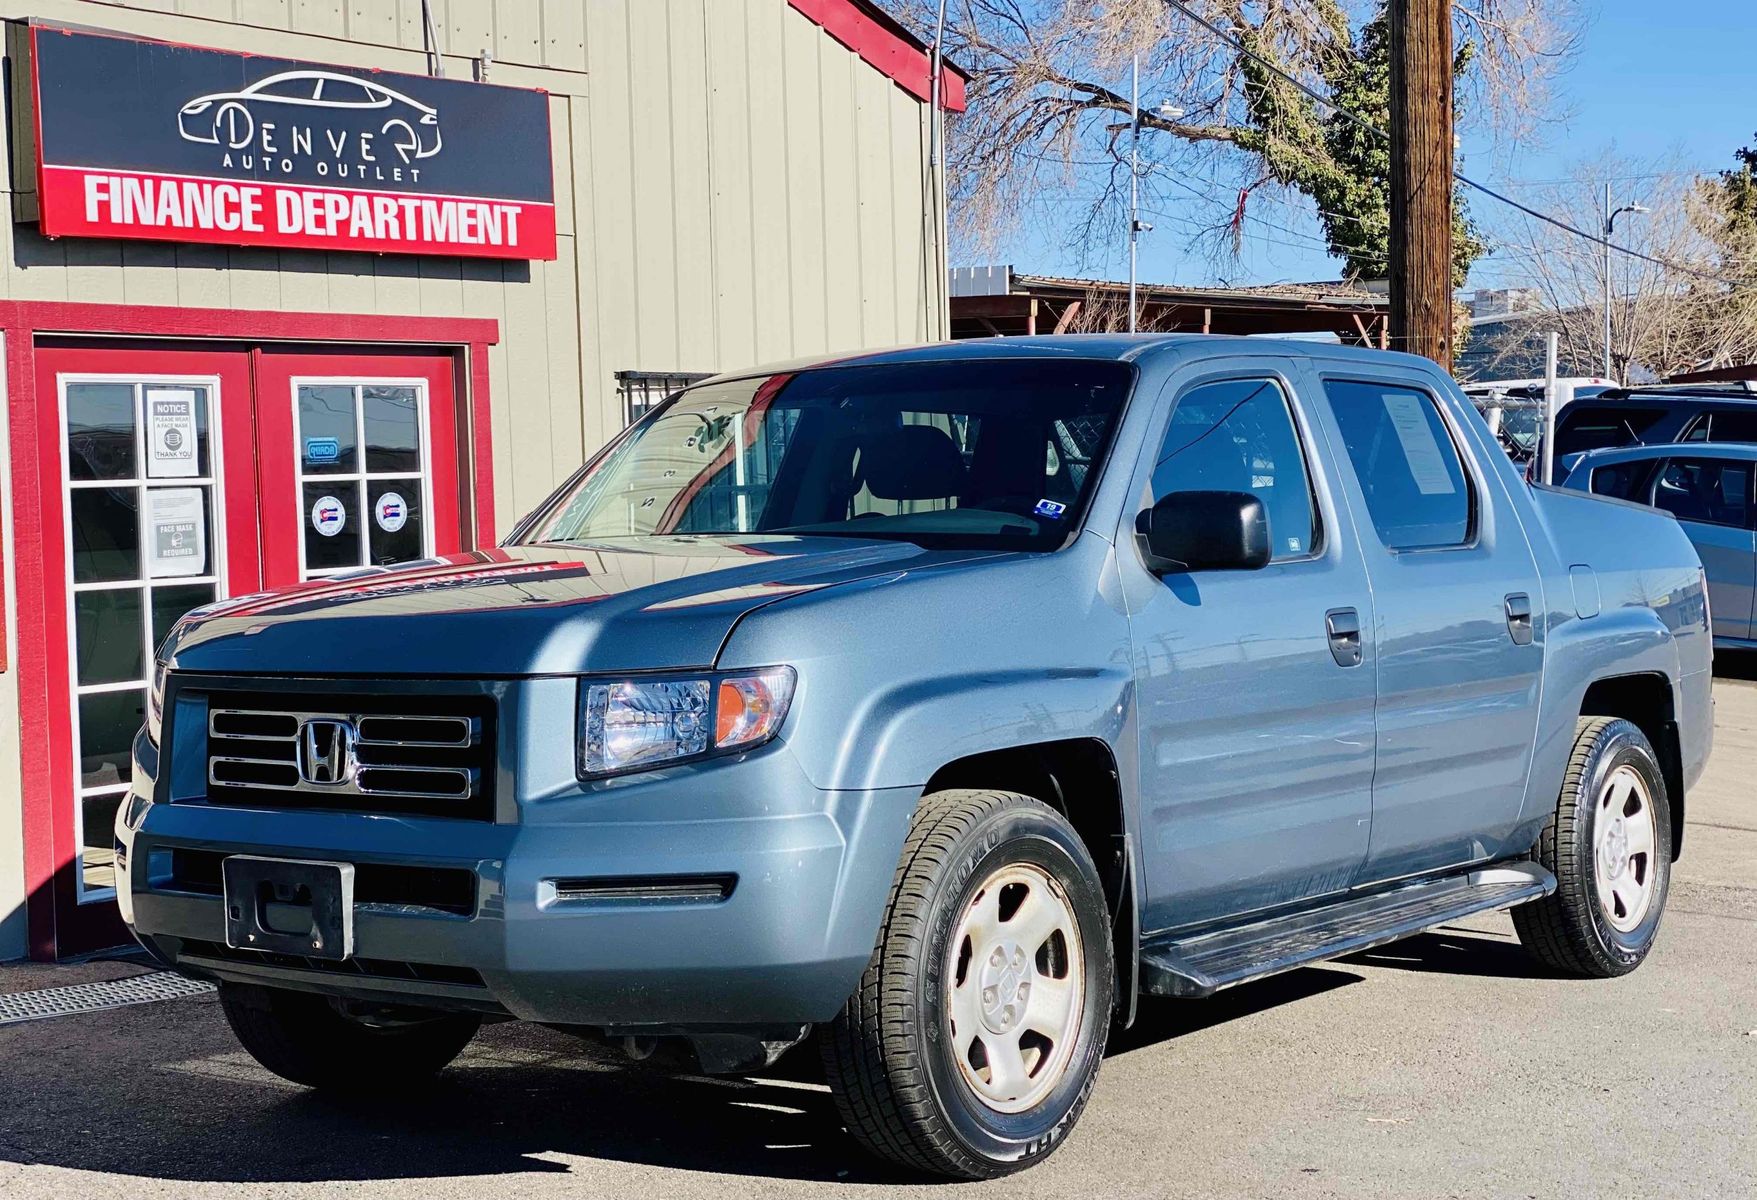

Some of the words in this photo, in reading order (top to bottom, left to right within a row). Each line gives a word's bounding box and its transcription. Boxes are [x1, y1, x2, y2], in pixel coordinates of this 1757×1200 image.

[216, 101, 418, 164] DENVER
[223, 153, 293, 173] AUTO
[317, 161, 420, 183] OUTLET
[84, 174, 264, 233] FINANCE
[275, 189, 521, 247] DEPARTMENT
[156, 404, 187, 413] NOTICE
[176, 524, 193, 532] MASK
[163, 548, 193, 556] REQUIRED
